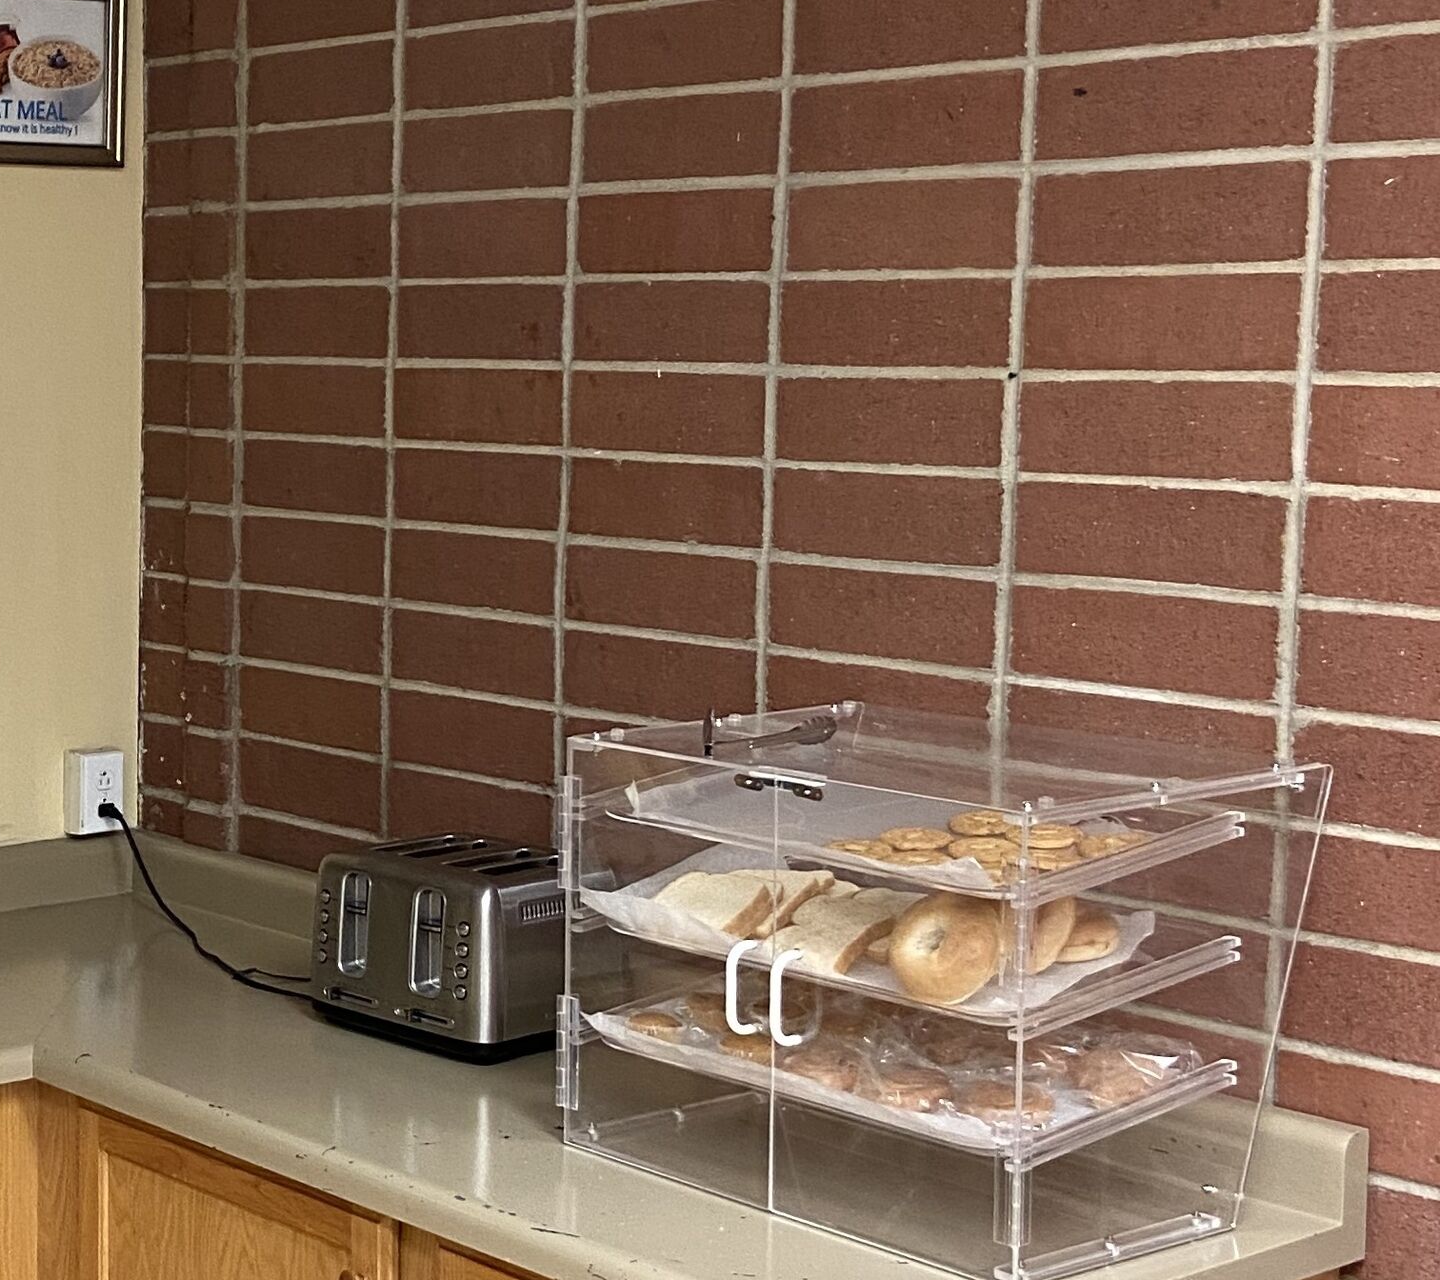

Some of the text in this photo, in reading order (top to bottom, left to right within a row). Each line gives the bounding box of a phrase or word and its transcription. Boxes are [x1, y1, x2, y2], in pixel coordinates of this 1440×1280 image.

[17, 100, 68, 121] MEAL
[22, 123, 28, 134] it
[30, 123, 38, 134] is
[40, 123, 72, 137] healthy
